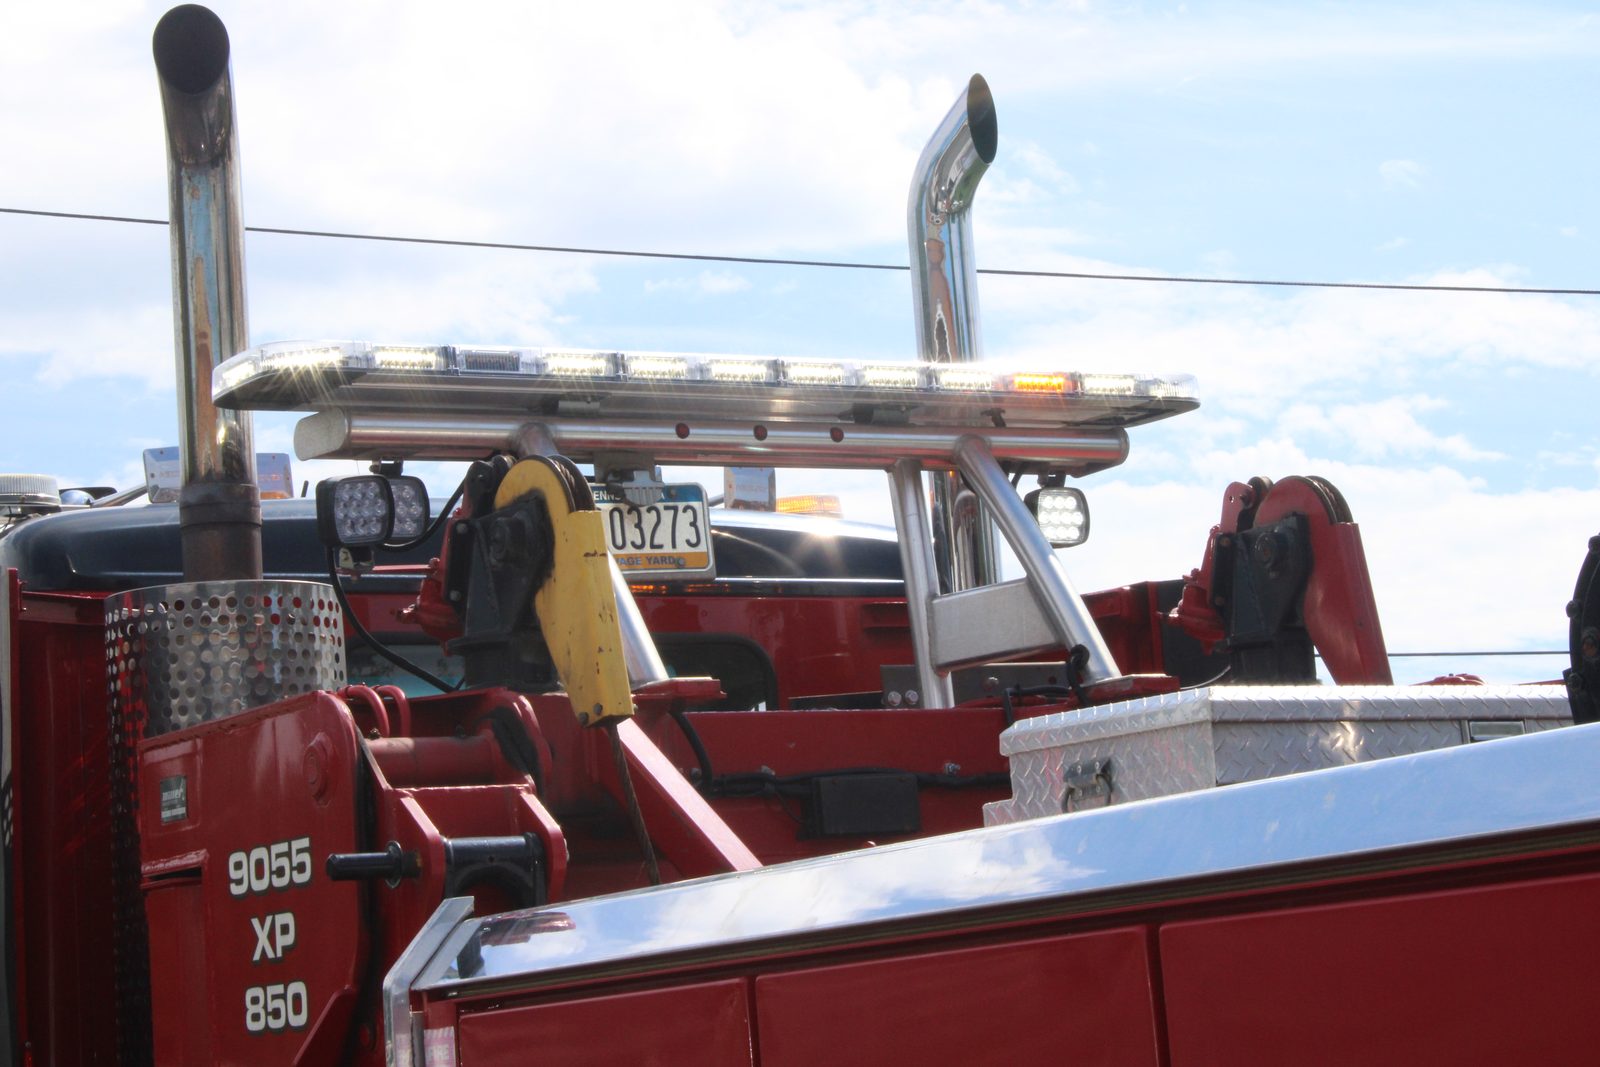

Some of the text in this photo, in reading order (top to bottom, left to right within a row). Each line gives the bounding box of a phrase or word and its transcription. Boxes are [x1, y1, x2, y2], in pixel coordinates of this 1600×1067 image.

[610, 505, 701, 550] 03273
[646, 556, 676, 565] YARD
[228, 837, 312, 896] 9055
[250, 912, 296, 962] XP
[245, 981, 308, 1032] 850
